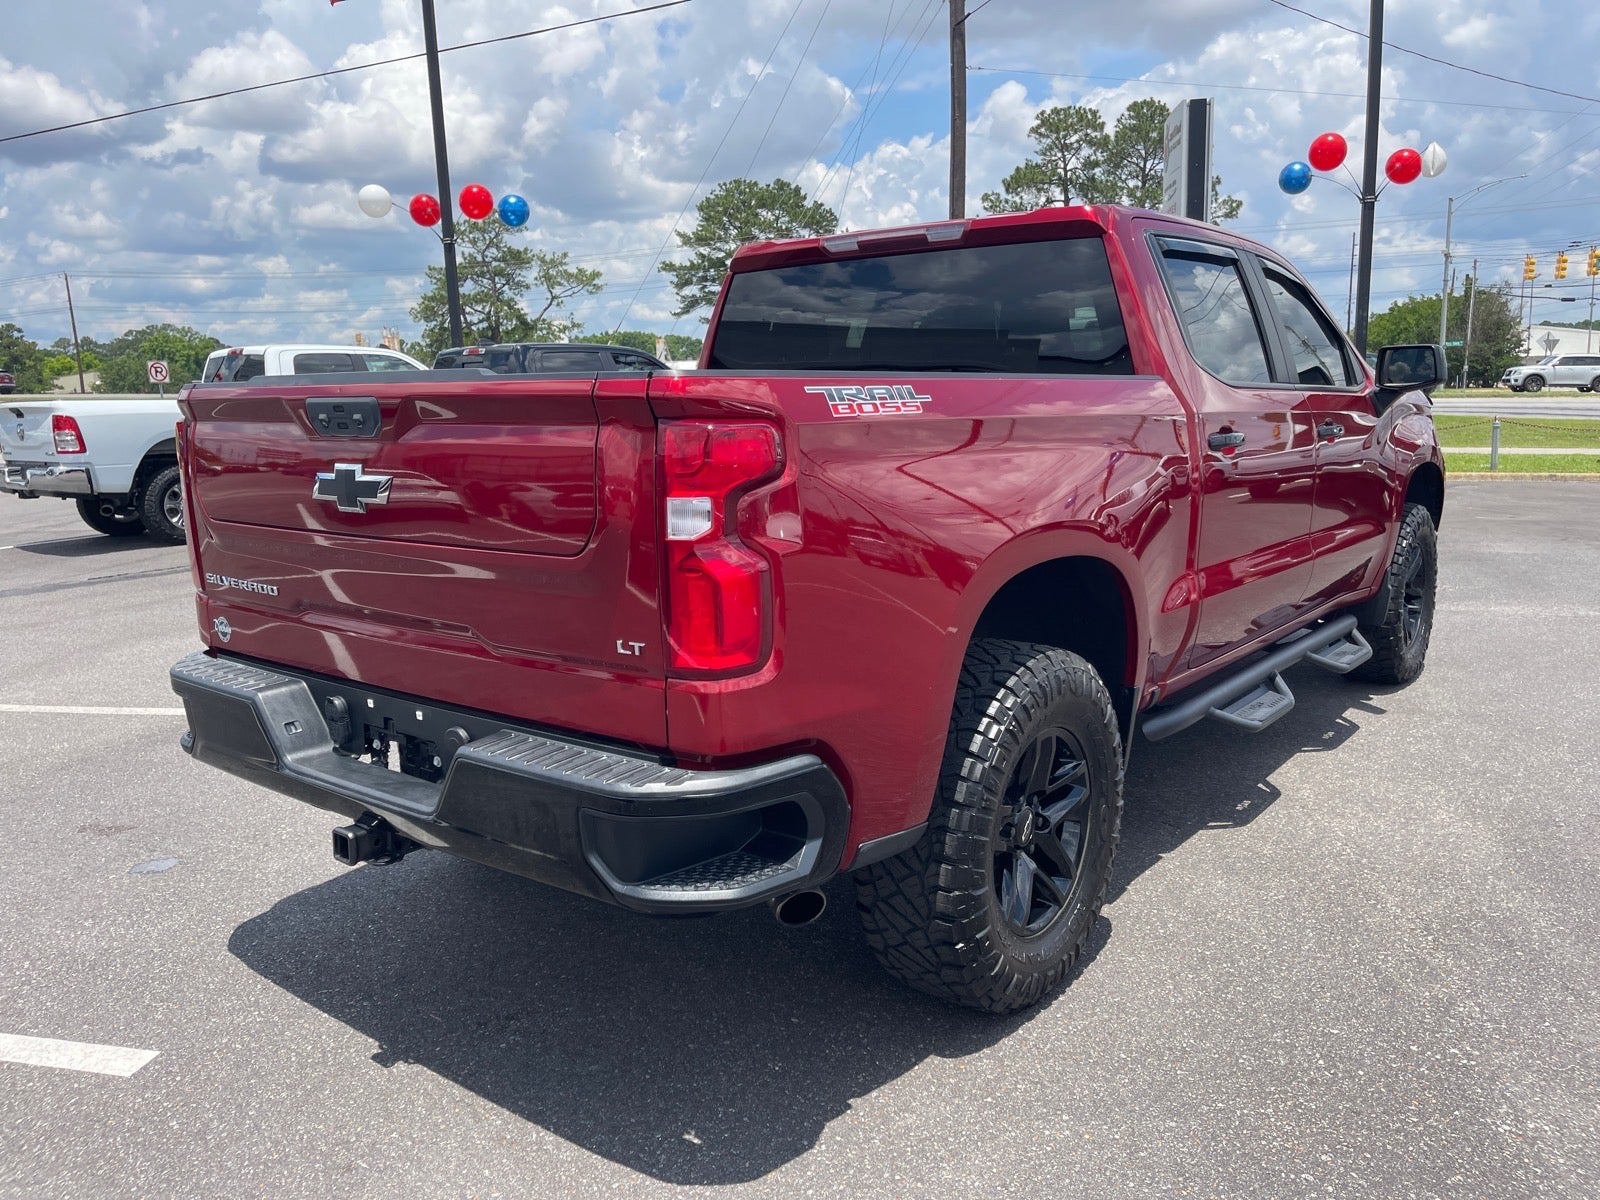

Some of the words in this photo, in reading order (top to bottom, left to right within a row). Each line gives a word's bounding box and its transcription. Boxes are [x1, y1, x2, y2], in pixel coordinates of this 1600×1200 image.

[804, 385, 932, 402] TRAIL
[829, 401, 923, 417] BOSS
[205, 573, 279, 596] SILVERADO
[616, 640, 646, 656] LT
